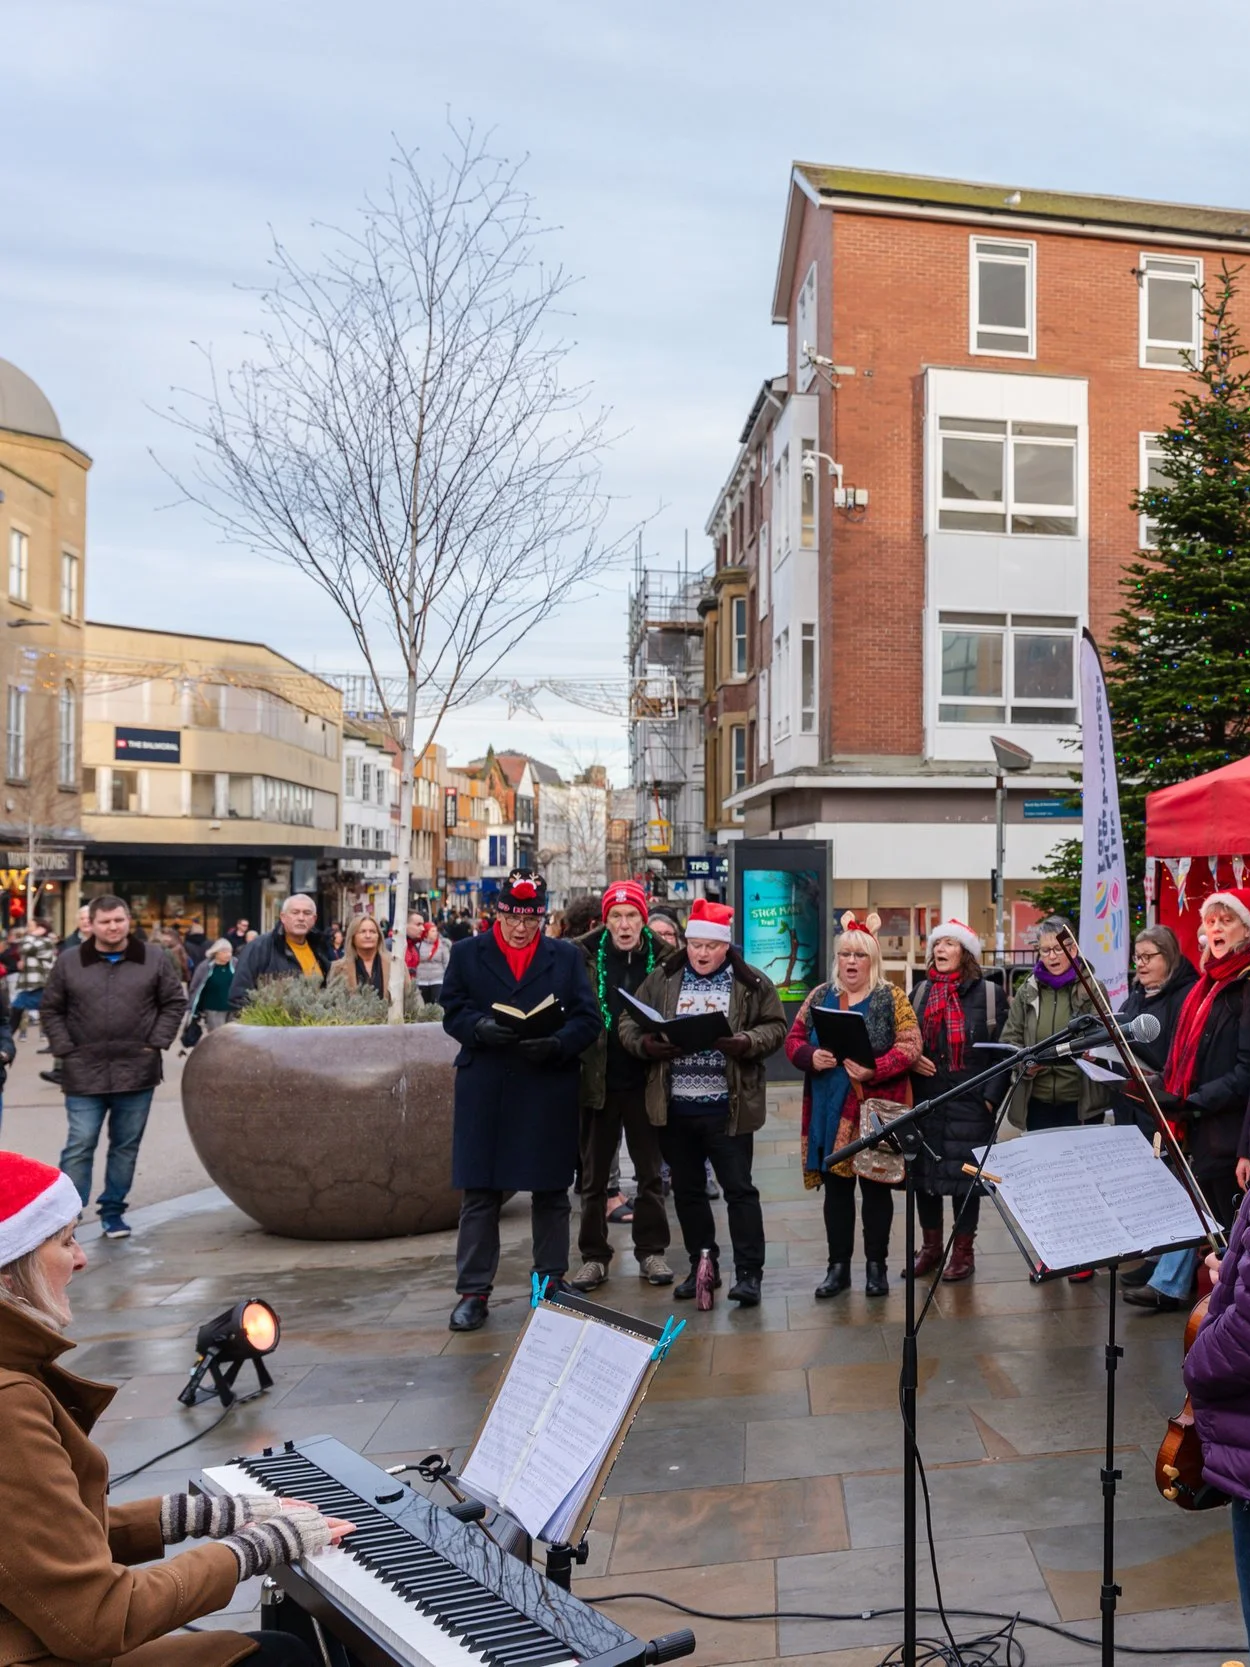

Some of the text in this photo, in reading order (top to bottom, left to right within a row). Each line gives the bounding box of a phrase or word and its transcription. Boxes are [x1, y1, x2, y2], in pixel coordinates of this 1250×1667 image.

[127, 740, 142, 749] THE
[689, 861, 710, 871] TFS
[751, 907, 777, 918] STICK
